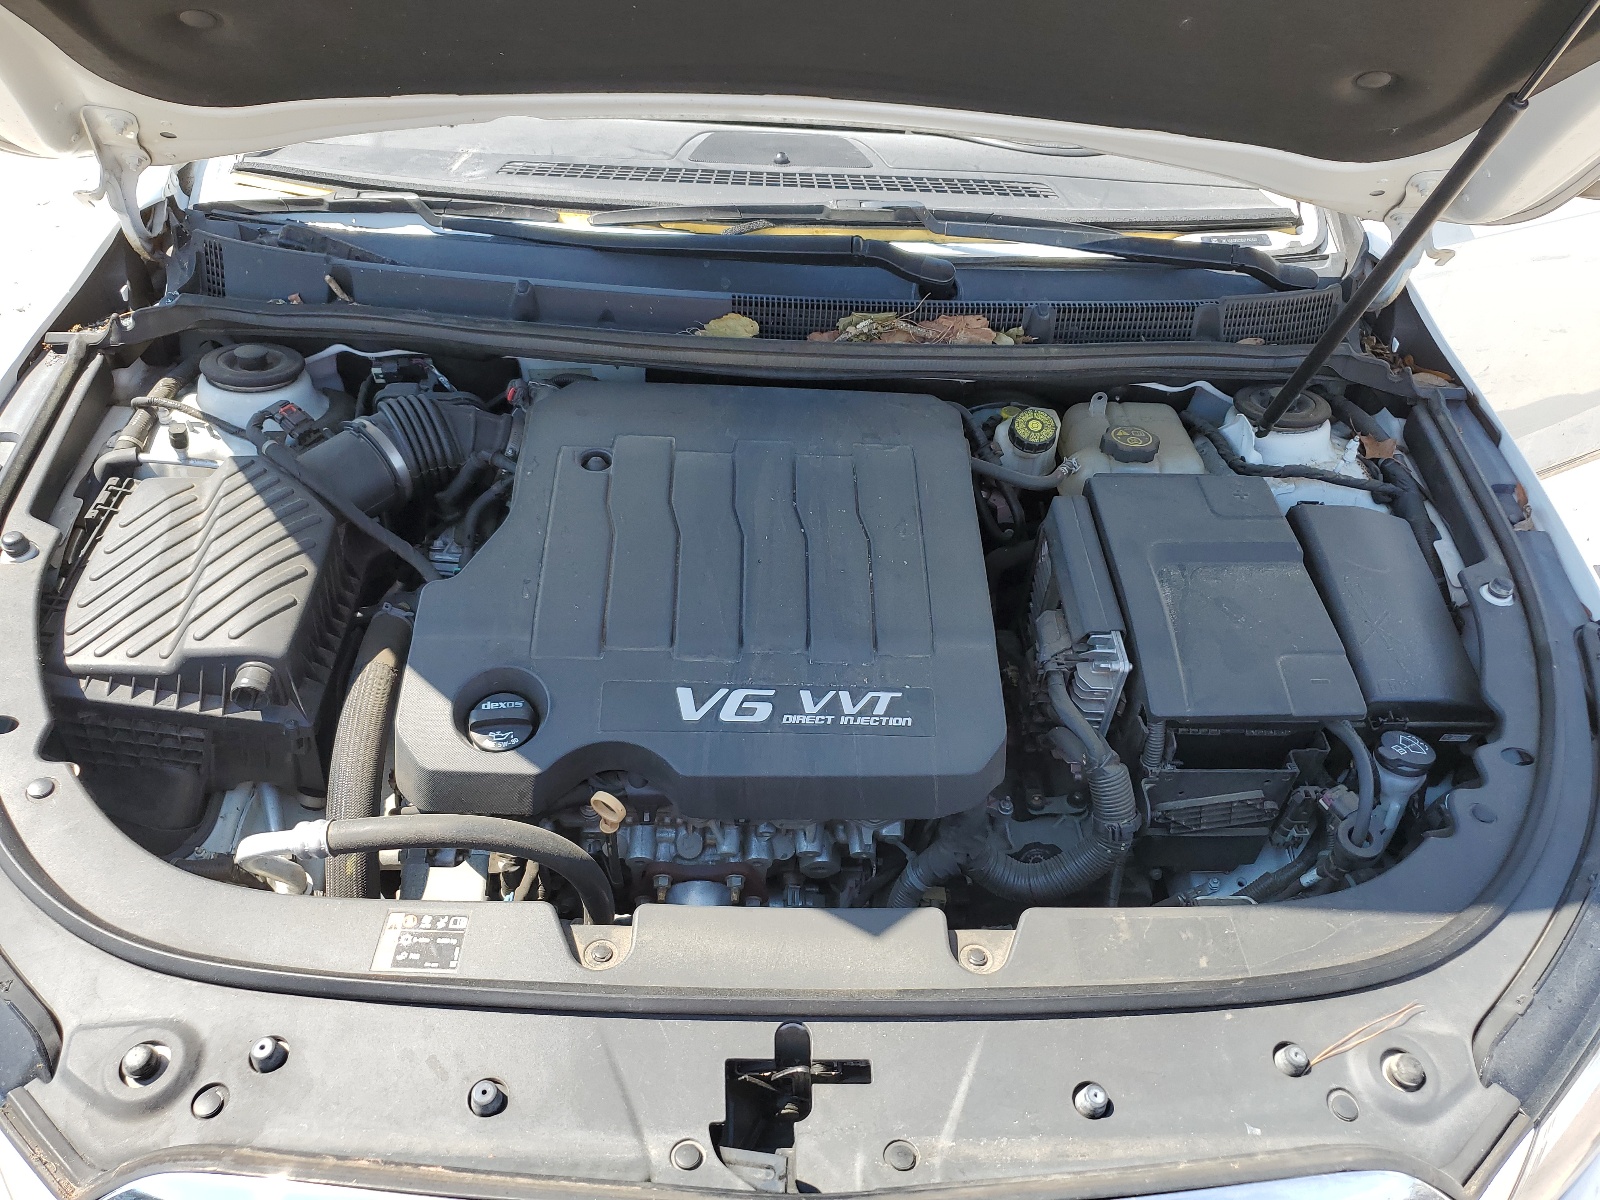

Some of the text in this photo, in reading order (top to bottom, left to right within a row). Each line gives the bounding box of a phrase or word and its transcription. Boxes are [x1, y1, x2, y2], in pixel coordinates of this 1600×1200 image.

[481, 701, 525, 710] dexos
[676, 687, 903, 722] V6 VVT
[782, 714, 912, 727] DIRECT INJECTION
